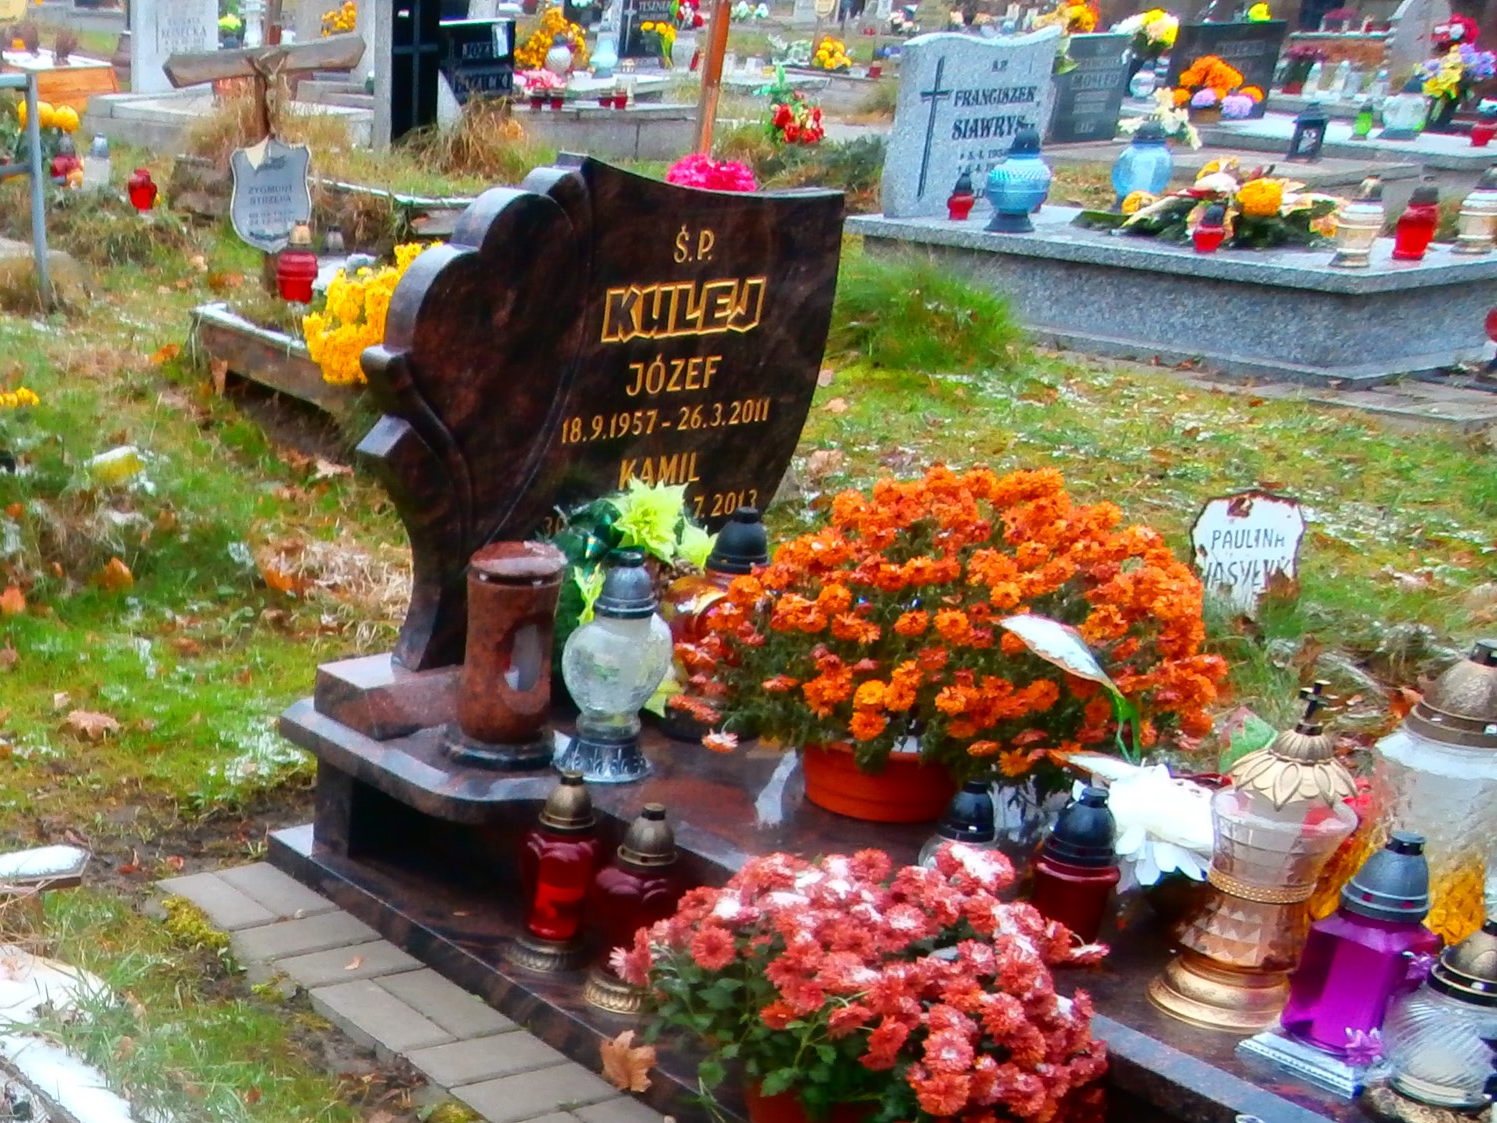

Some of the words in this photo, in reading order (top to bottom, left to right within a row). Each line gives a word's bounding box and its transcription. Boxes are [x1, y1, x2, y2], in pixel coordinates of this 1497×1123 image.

[954, 86, 1038, 107] FRANCISZEK
[601, 275, 767, 343] KULEJ
[626, 354, 722, 397] JÓZEF
[562, 409, 659, 444] 18.9.1957
[677, 397, 770, 431] 26.3.2011
[619, 452, 701, 491] KAMIL
[1211, 528, 1285, 550] PAULINA
